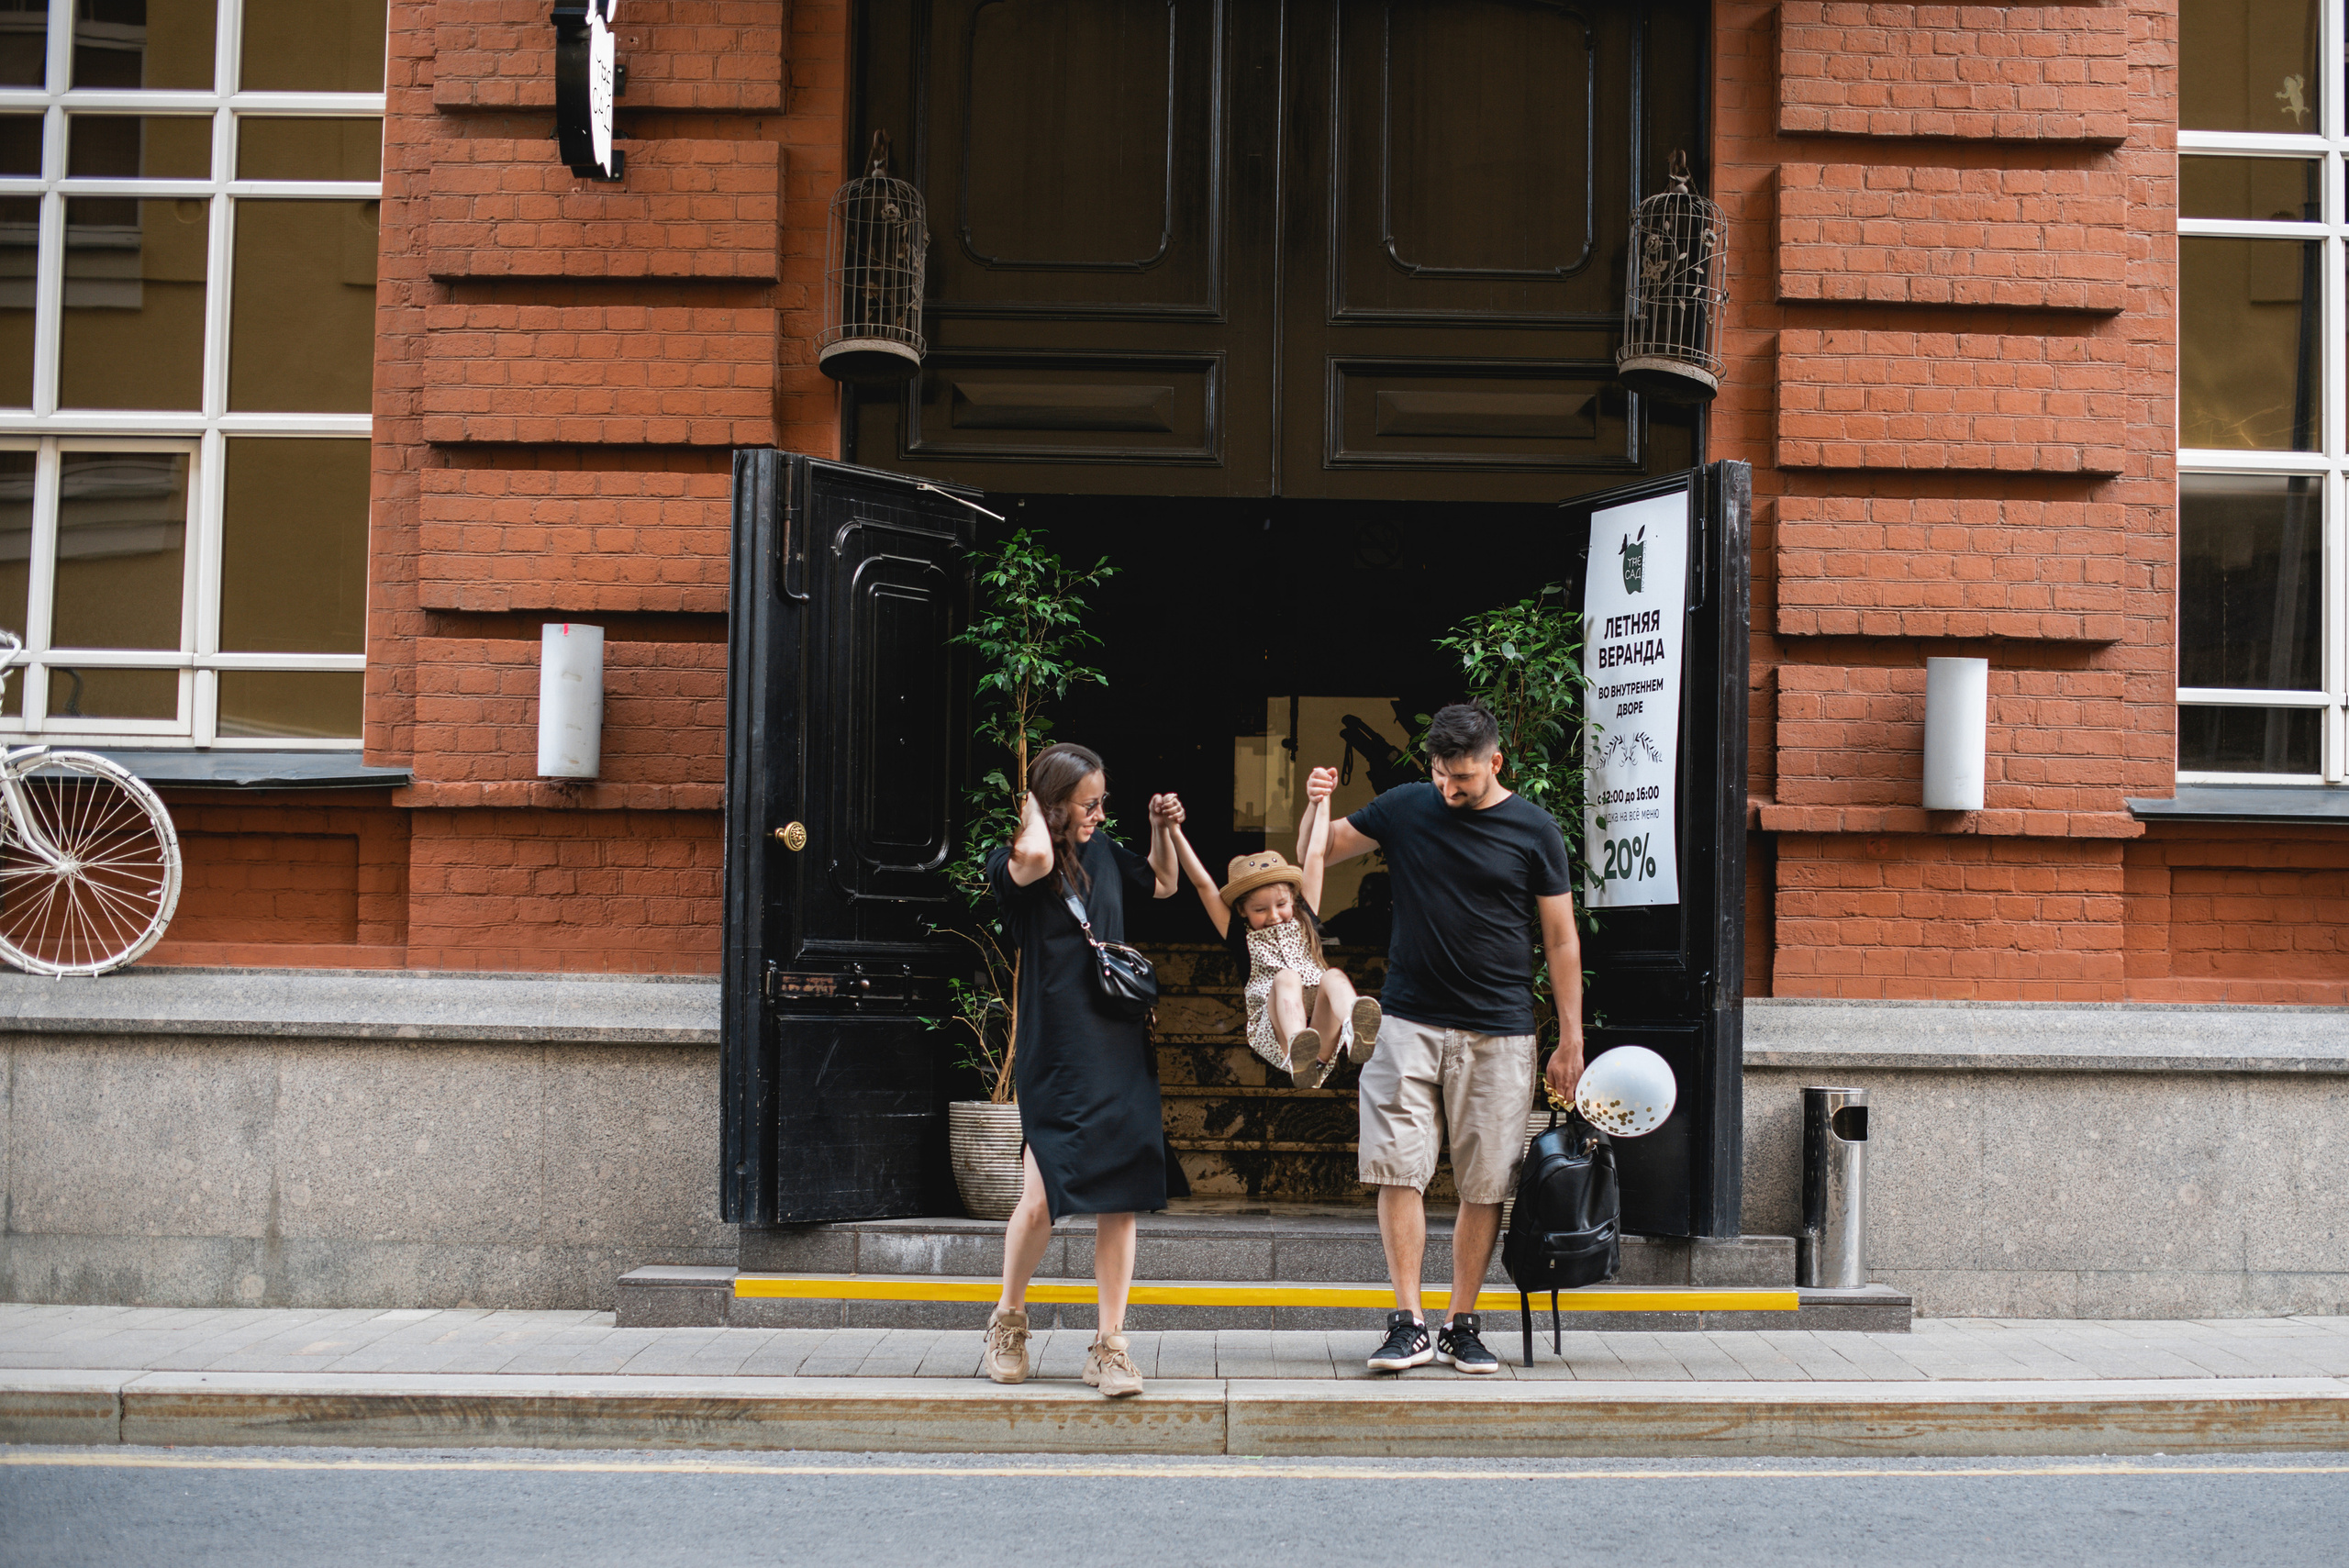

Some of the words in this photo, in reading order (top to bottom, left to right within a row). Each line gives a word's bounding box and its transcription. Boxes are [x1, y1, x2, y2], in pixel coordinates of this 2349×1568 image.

[1624, 567, 1642, 581] САД
[1604, 609, 1661, 640] ЛЕТНЯЯ
[1598, 638, 1665, 669] ВЕРАНДА
[1598, 684, 1610, 700] ВО
[1610, 677, 1664, 698] ВНУТРЕННЕМ
[1616, 700, 1643, 718] ДВОРЕ
[1625, 791, 1635, 805] до
[1636, 785, 1660, 801] 16:00
[1620, 811, 1628, 822] на
[1629, 807, 1640, 821] всё
[1641, 808, 1660, 820] меню
[1603, 832, 1657, 882] 20%
